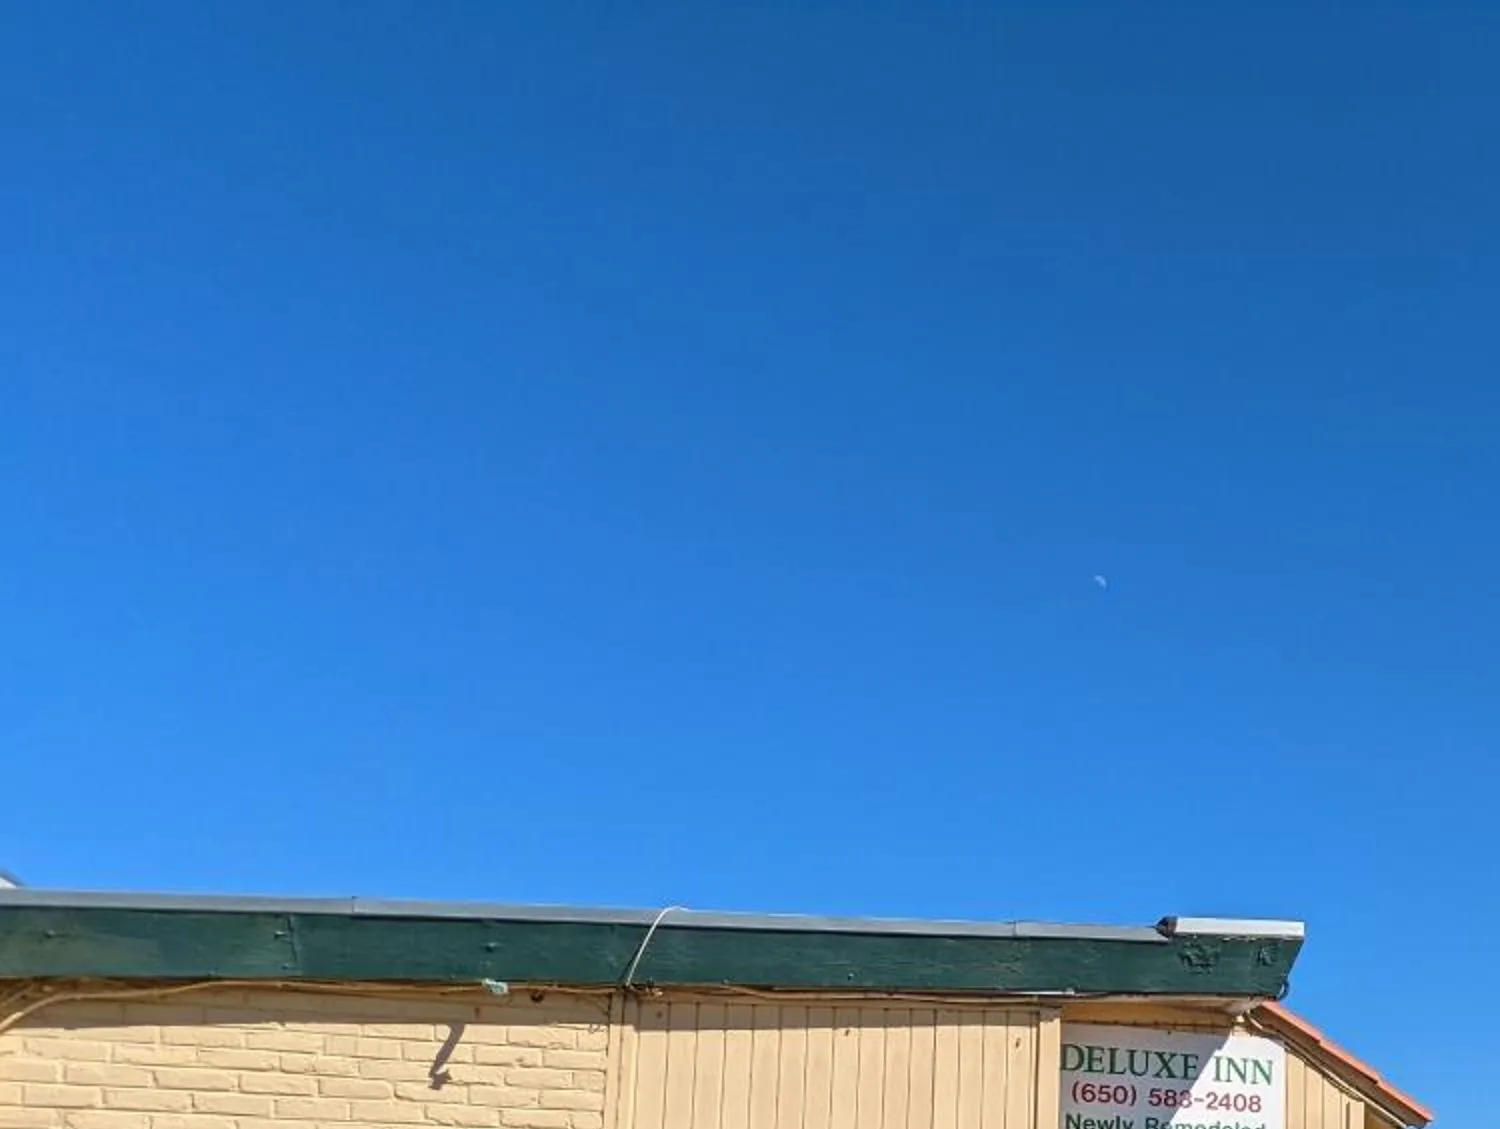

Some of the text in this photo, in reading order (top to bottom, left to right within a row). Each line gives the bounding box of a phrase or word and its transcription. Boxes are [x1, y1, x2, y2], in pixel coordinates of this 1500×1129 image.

[1060, 1043, 1273, 1086] DELUXE INN
[1071, 1080, 1137, 1107] (650)
